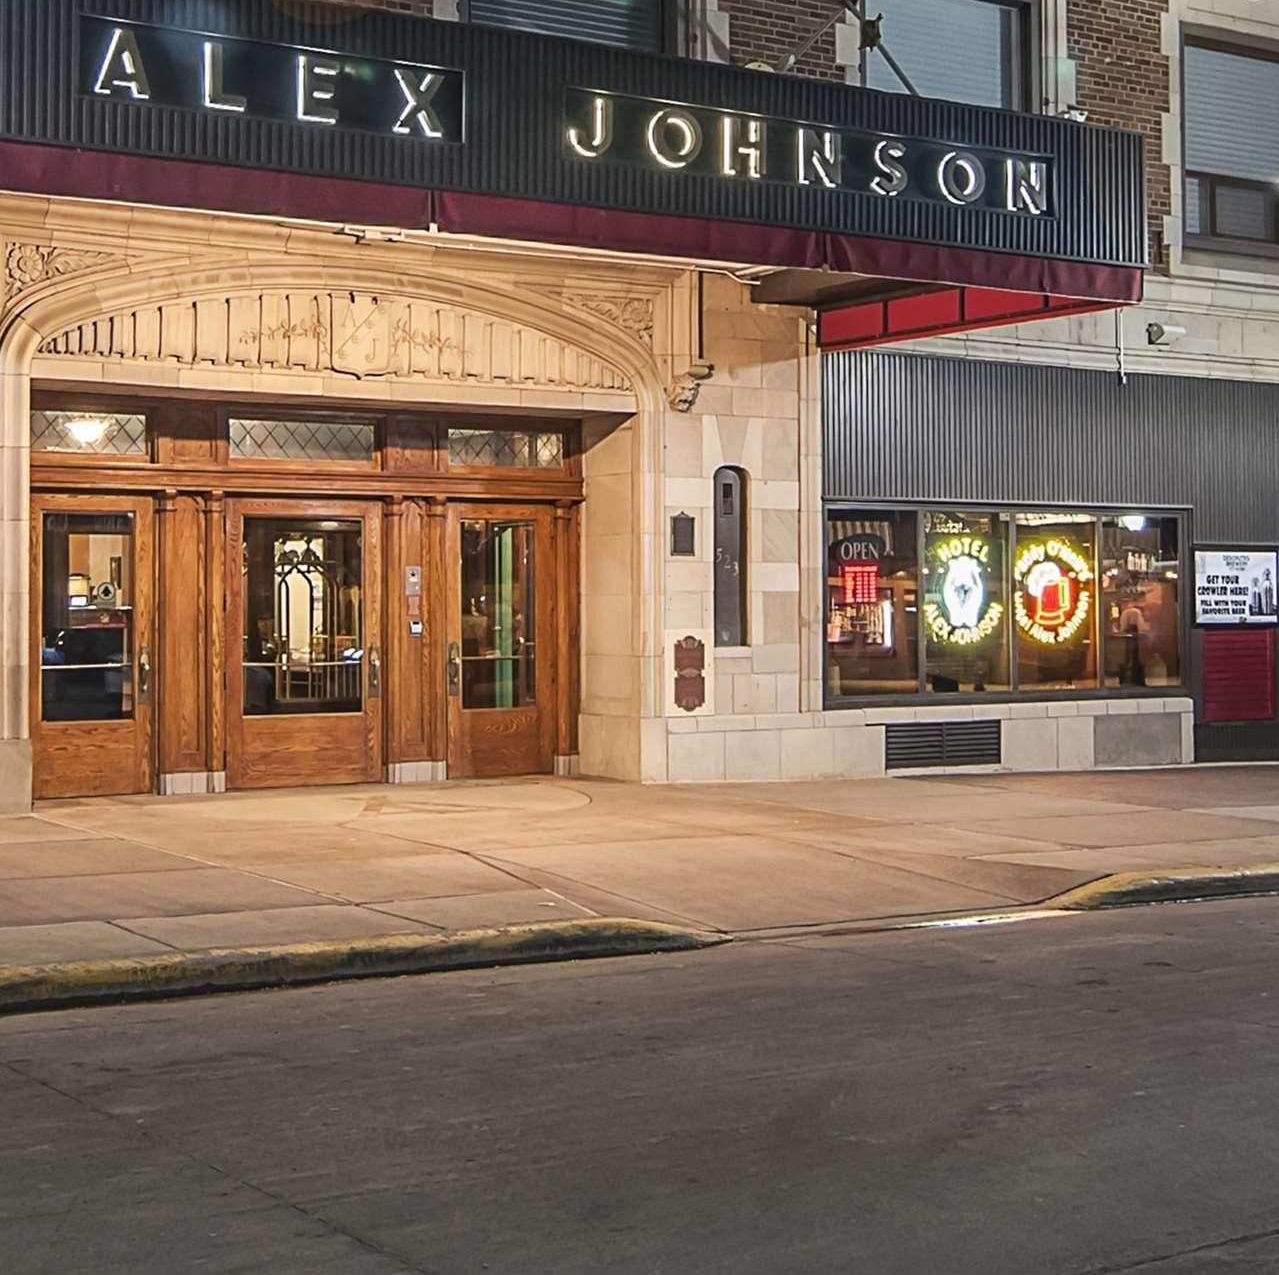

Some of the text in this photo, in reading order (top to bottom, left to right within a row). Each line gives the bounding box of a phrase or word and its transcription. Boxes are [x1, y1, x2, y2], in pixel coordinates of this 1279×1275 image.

[93, 27, 1048, 216] ALEX JOHNSON
[840, 541, 880, 560] OPEN
[937, 537, 989, 563] HOTEL
[1206, 575, 1240, 585] GET YOUR
[923, 602, 1004, 645] ALEX JOHNSON
